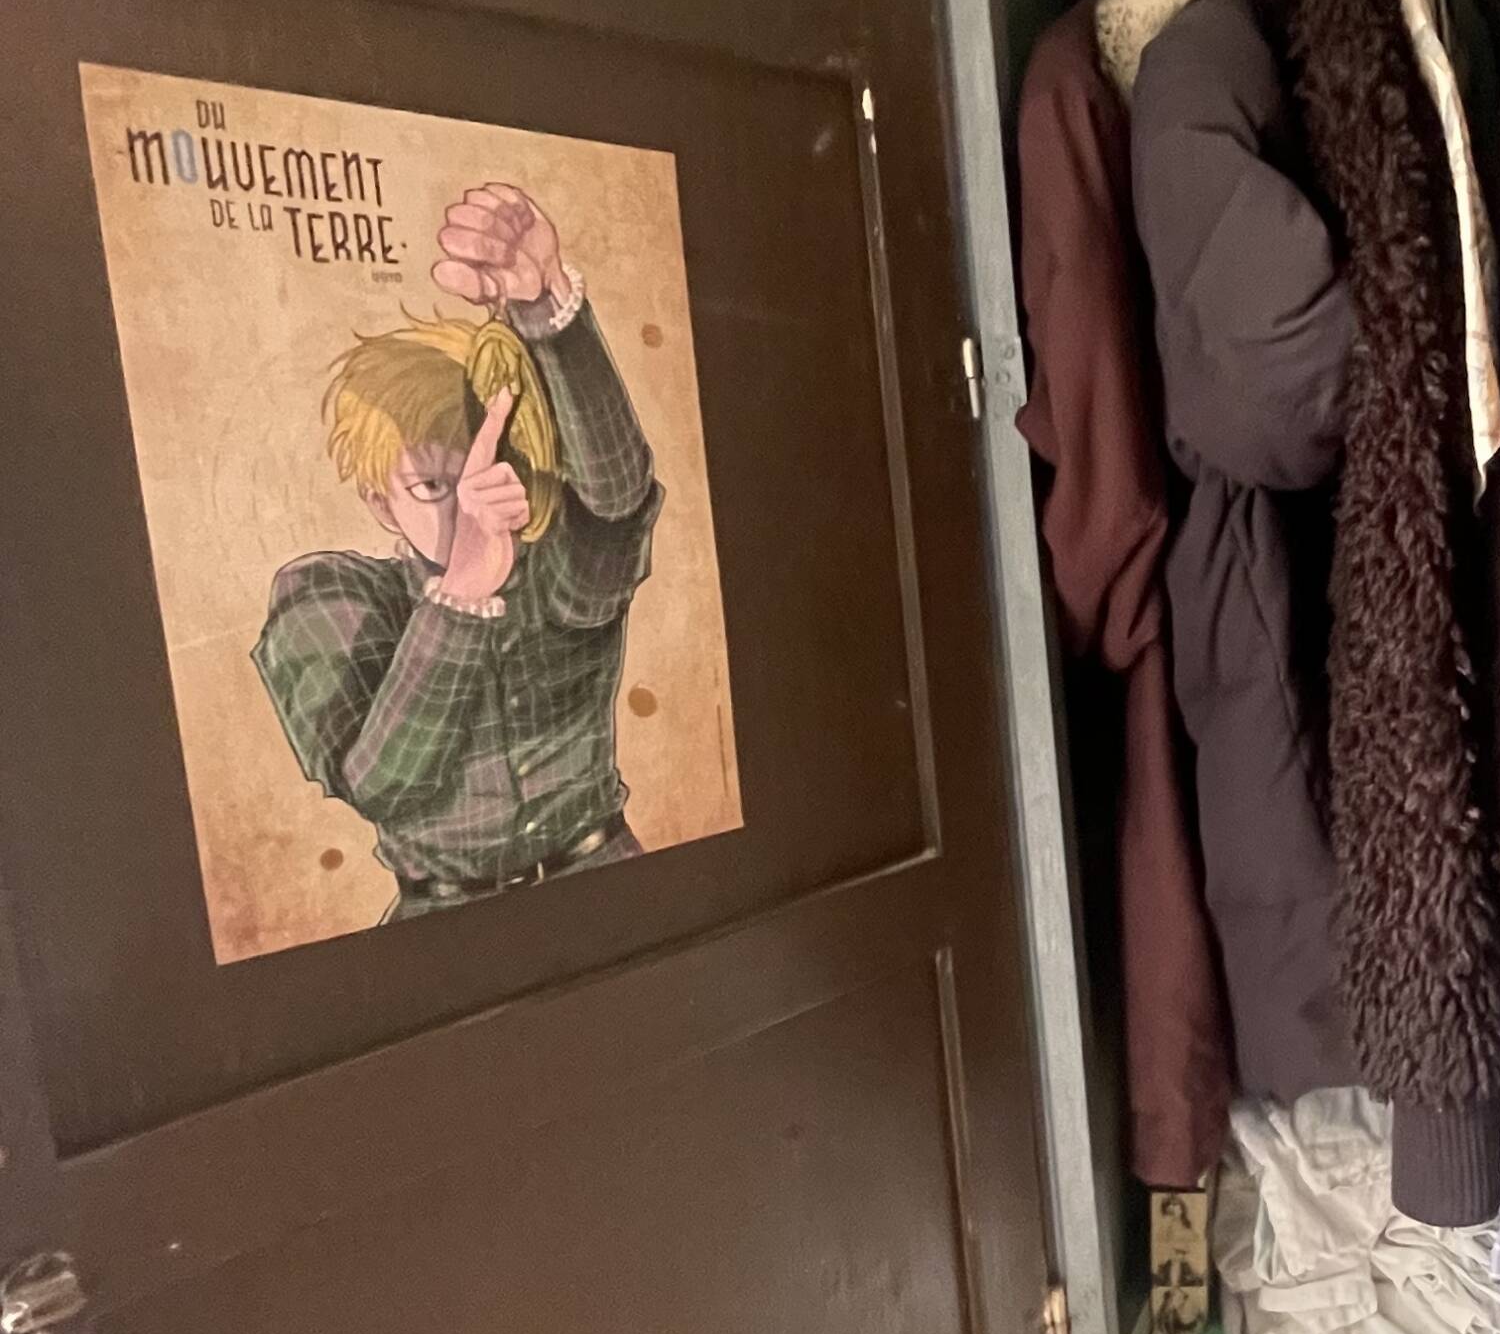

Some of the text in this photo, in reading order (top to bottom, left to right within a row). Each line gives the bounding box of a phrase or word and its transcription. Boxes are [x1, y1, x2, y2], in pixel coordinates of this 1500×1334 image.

[196, 99, 226, 130] DU
[209, 198, 240, 230] DE
[247, 201, 274, 232] LA
